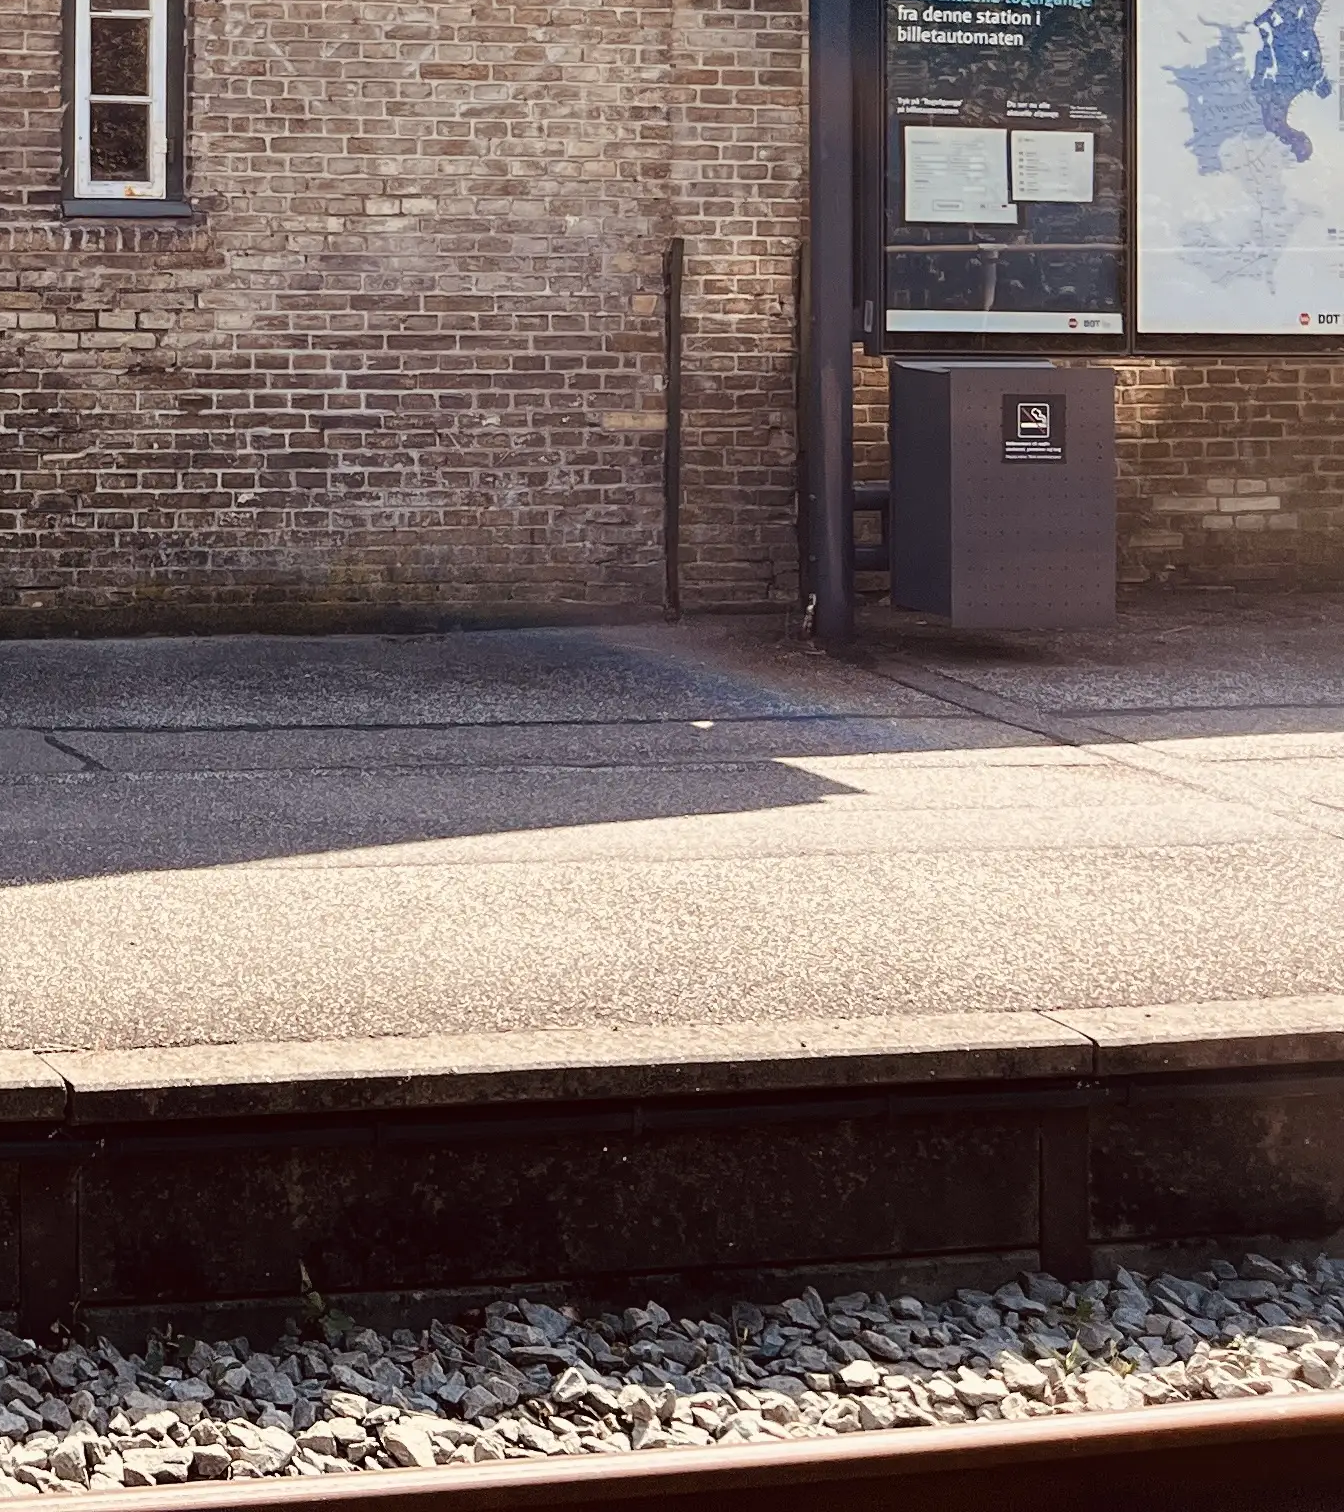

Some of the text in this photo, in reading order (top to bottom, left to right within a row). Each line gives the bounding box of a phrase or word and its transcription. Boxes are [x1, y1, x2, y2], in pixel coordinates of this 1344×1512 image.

[897, 5, 1042, 26] fra denne station i
[897, 26, 1024, 46] billetautomaten
[1318, 313, 1340, 325] DOT
